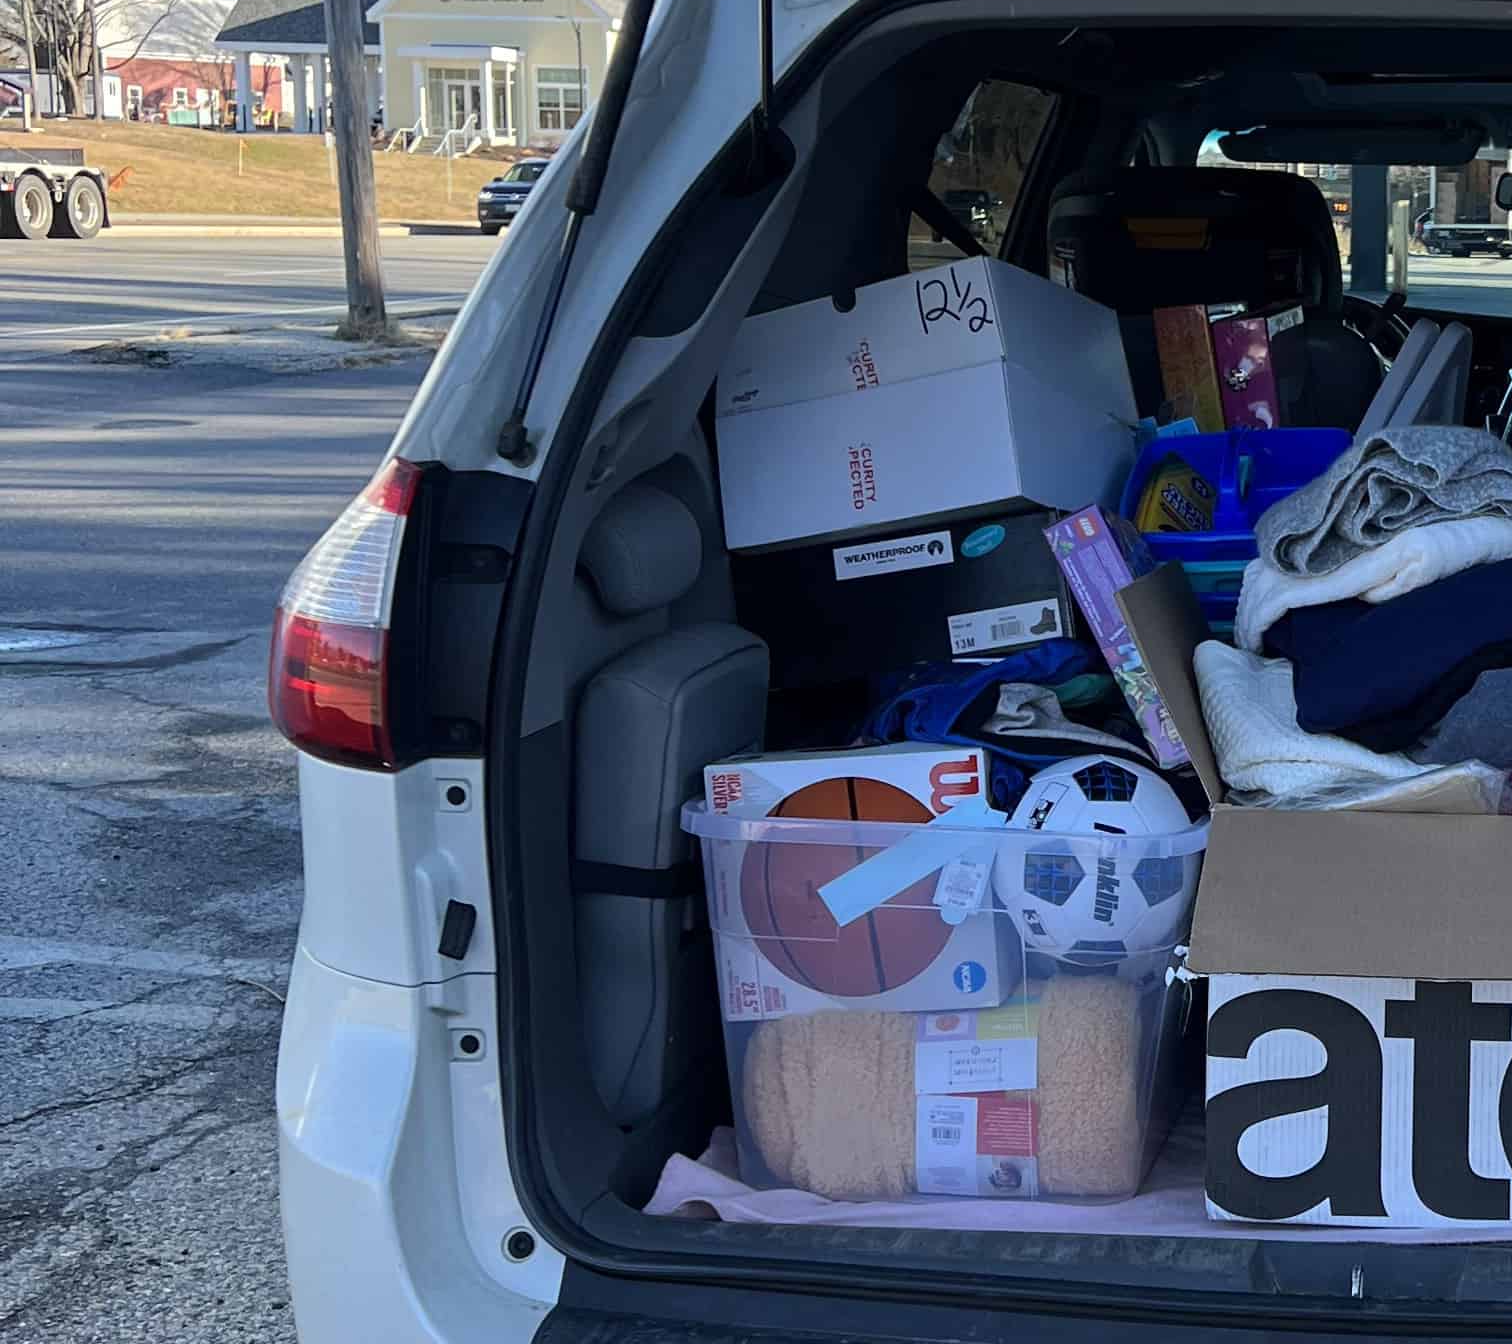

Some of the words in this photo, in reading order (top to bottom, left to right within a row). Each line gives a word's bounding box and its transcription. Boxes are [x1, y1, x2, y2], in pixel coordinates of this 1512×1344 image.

[860, 442, 877, 502] CURITY
[844, 543, 925, 564] WEATHERPROOF
[712, 775, 728, 809] SILVER
